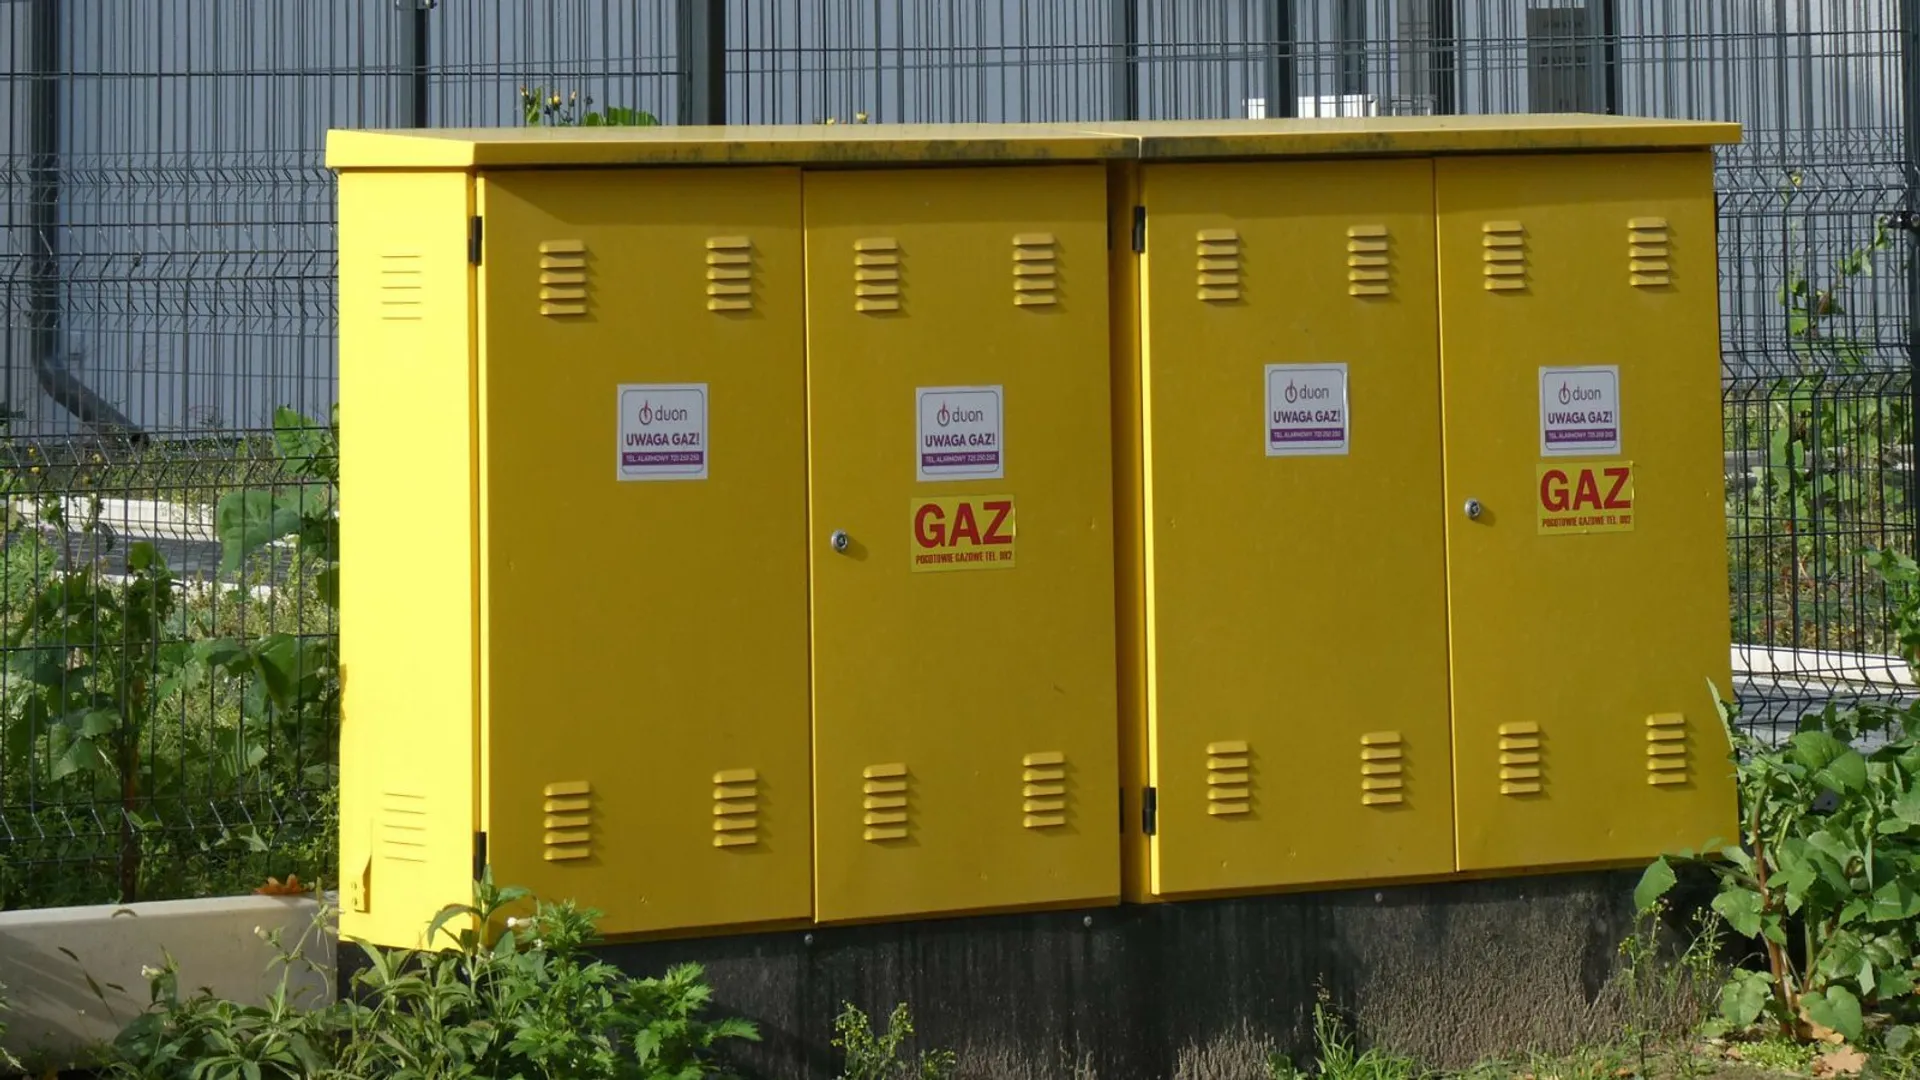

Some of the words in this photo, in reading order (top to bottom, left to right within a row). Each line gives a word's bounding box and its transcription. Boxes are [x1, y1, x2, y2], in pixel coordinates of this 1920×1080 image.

[1299, 384, 1329, 400] duon
[1573, 385, 1602, 401] duon
[655, 404, 688, 421] duon
[952, 405, 983, 422] duon
[1273, 409, 1313, 423] UWAGA
[1315, 409, 1341, 423] GAZ!
[1547, 411, 1586, 425] UWAGA
[1588, 410, 1613, 424] GAZ!
[626, 433, 669, 446] UWAGA
[672, 432, 700, 446] GAZ!
[925, 433, 966, 448] UWAGA
[968, 432, 996, 447] GAZ!
[637, 454, 669, 462] ALARMOWY
[936, 454, 966, 463] ALARMOWY
[1540, 467, 1631, 512] GAZ
[914, 501, 1012, 549] GAZ
[1542, 517, 1577, 527] POGOTOWIE
[1578, 516, 1604, 526] GAZOWE
[915, 553, 953, 565] POGOTOWIE
[955, 552, 983, 563] GAZOWE
